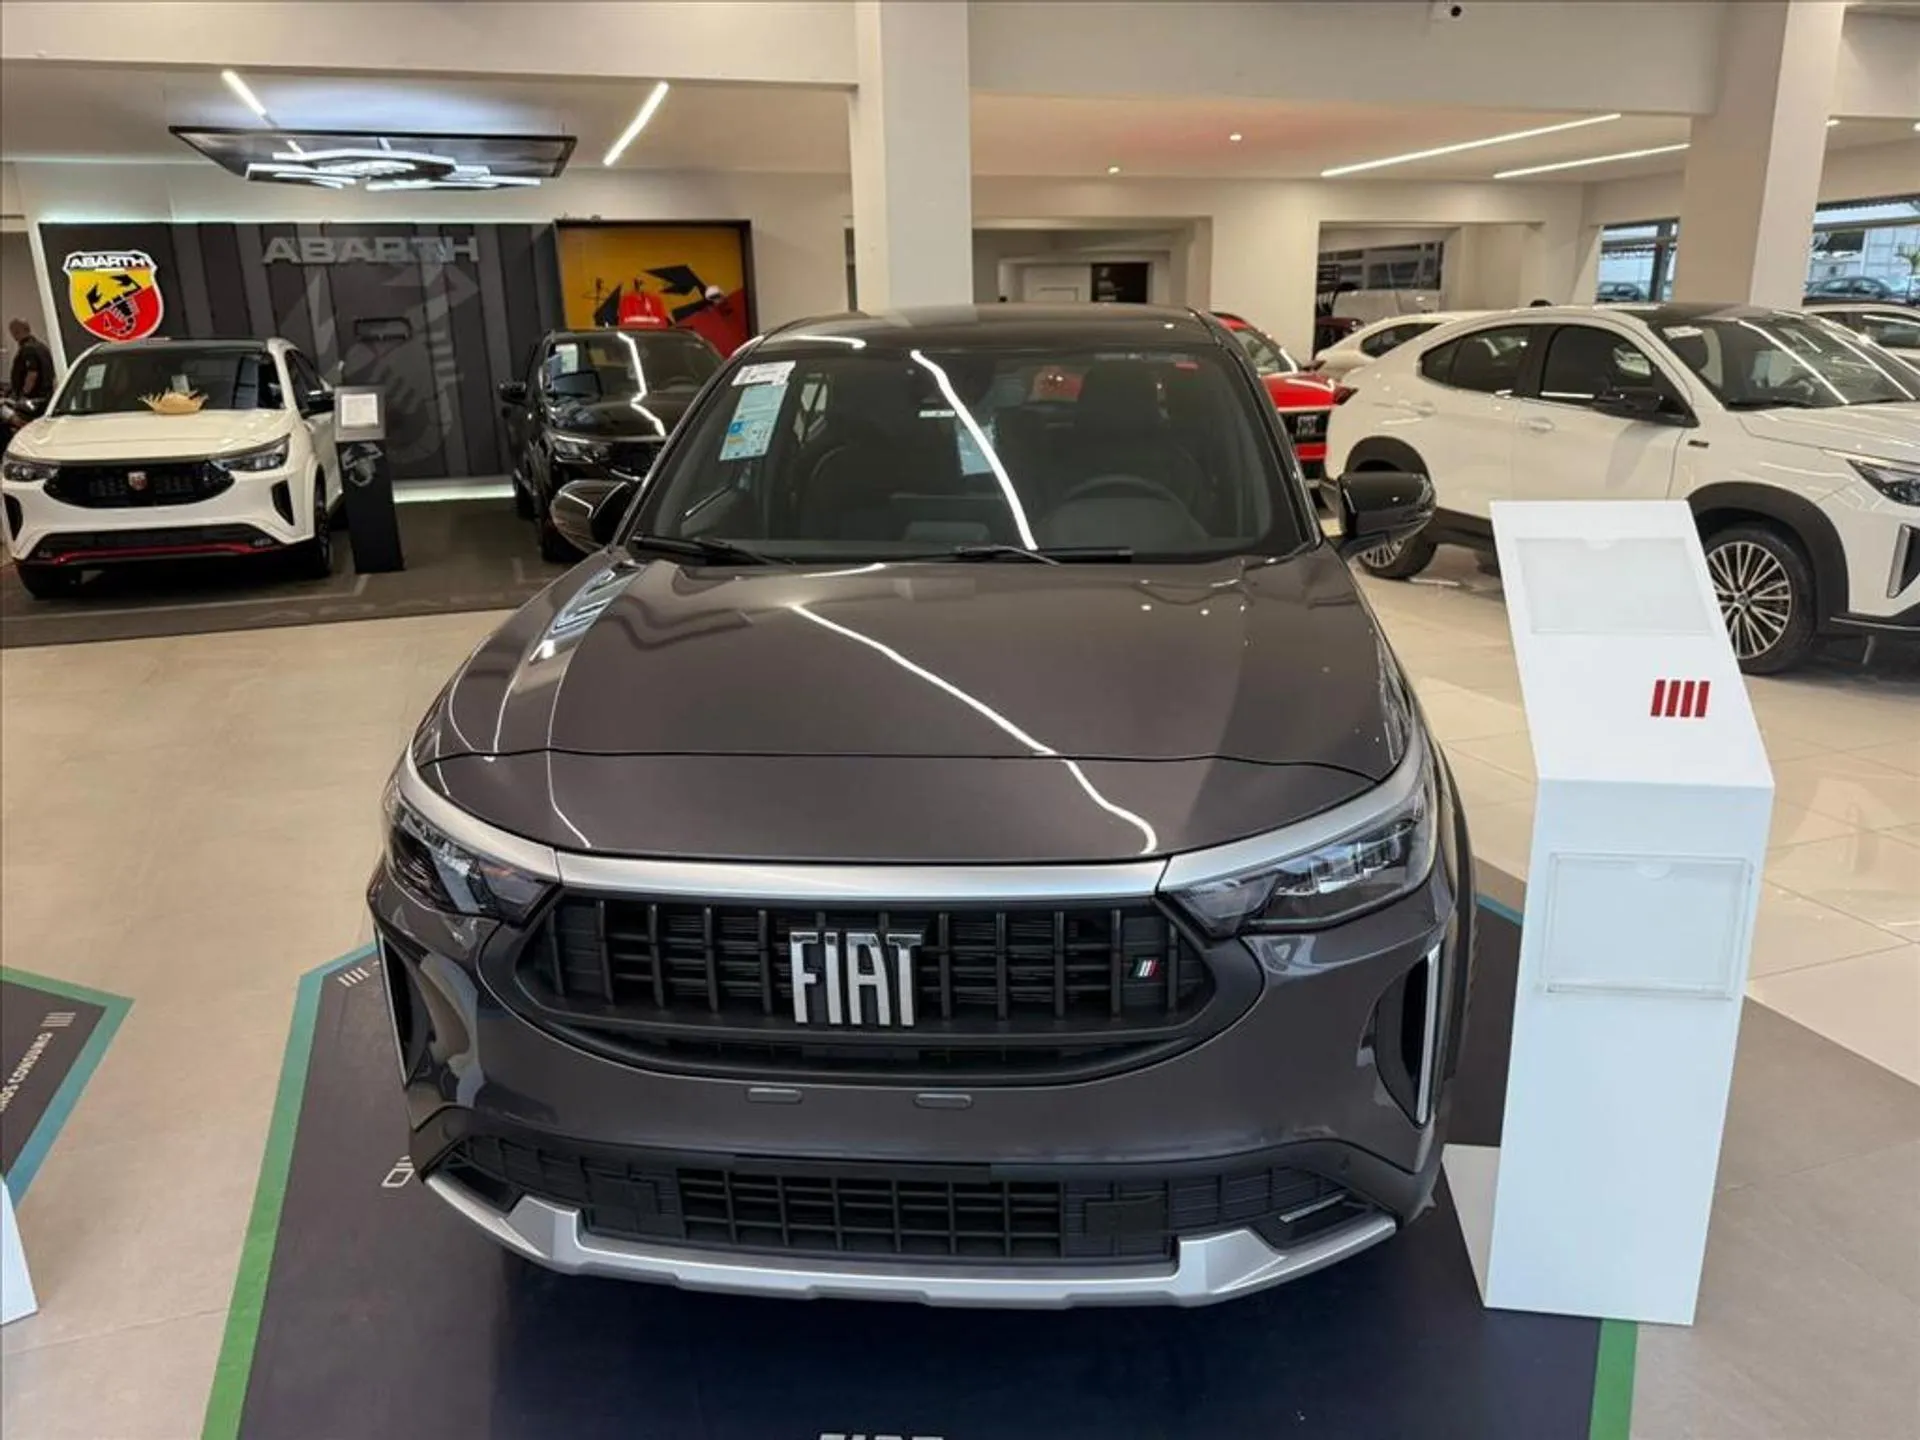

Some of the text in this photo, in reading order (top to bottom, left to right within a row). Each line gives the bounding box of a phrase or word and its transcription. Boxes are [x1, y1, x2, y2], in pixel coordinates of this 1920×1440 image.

[70, 255, 149, 268] ABARTH
[262, 236, 480, 263] ABARTH
[790, 931, 923, 1026] FIAT
